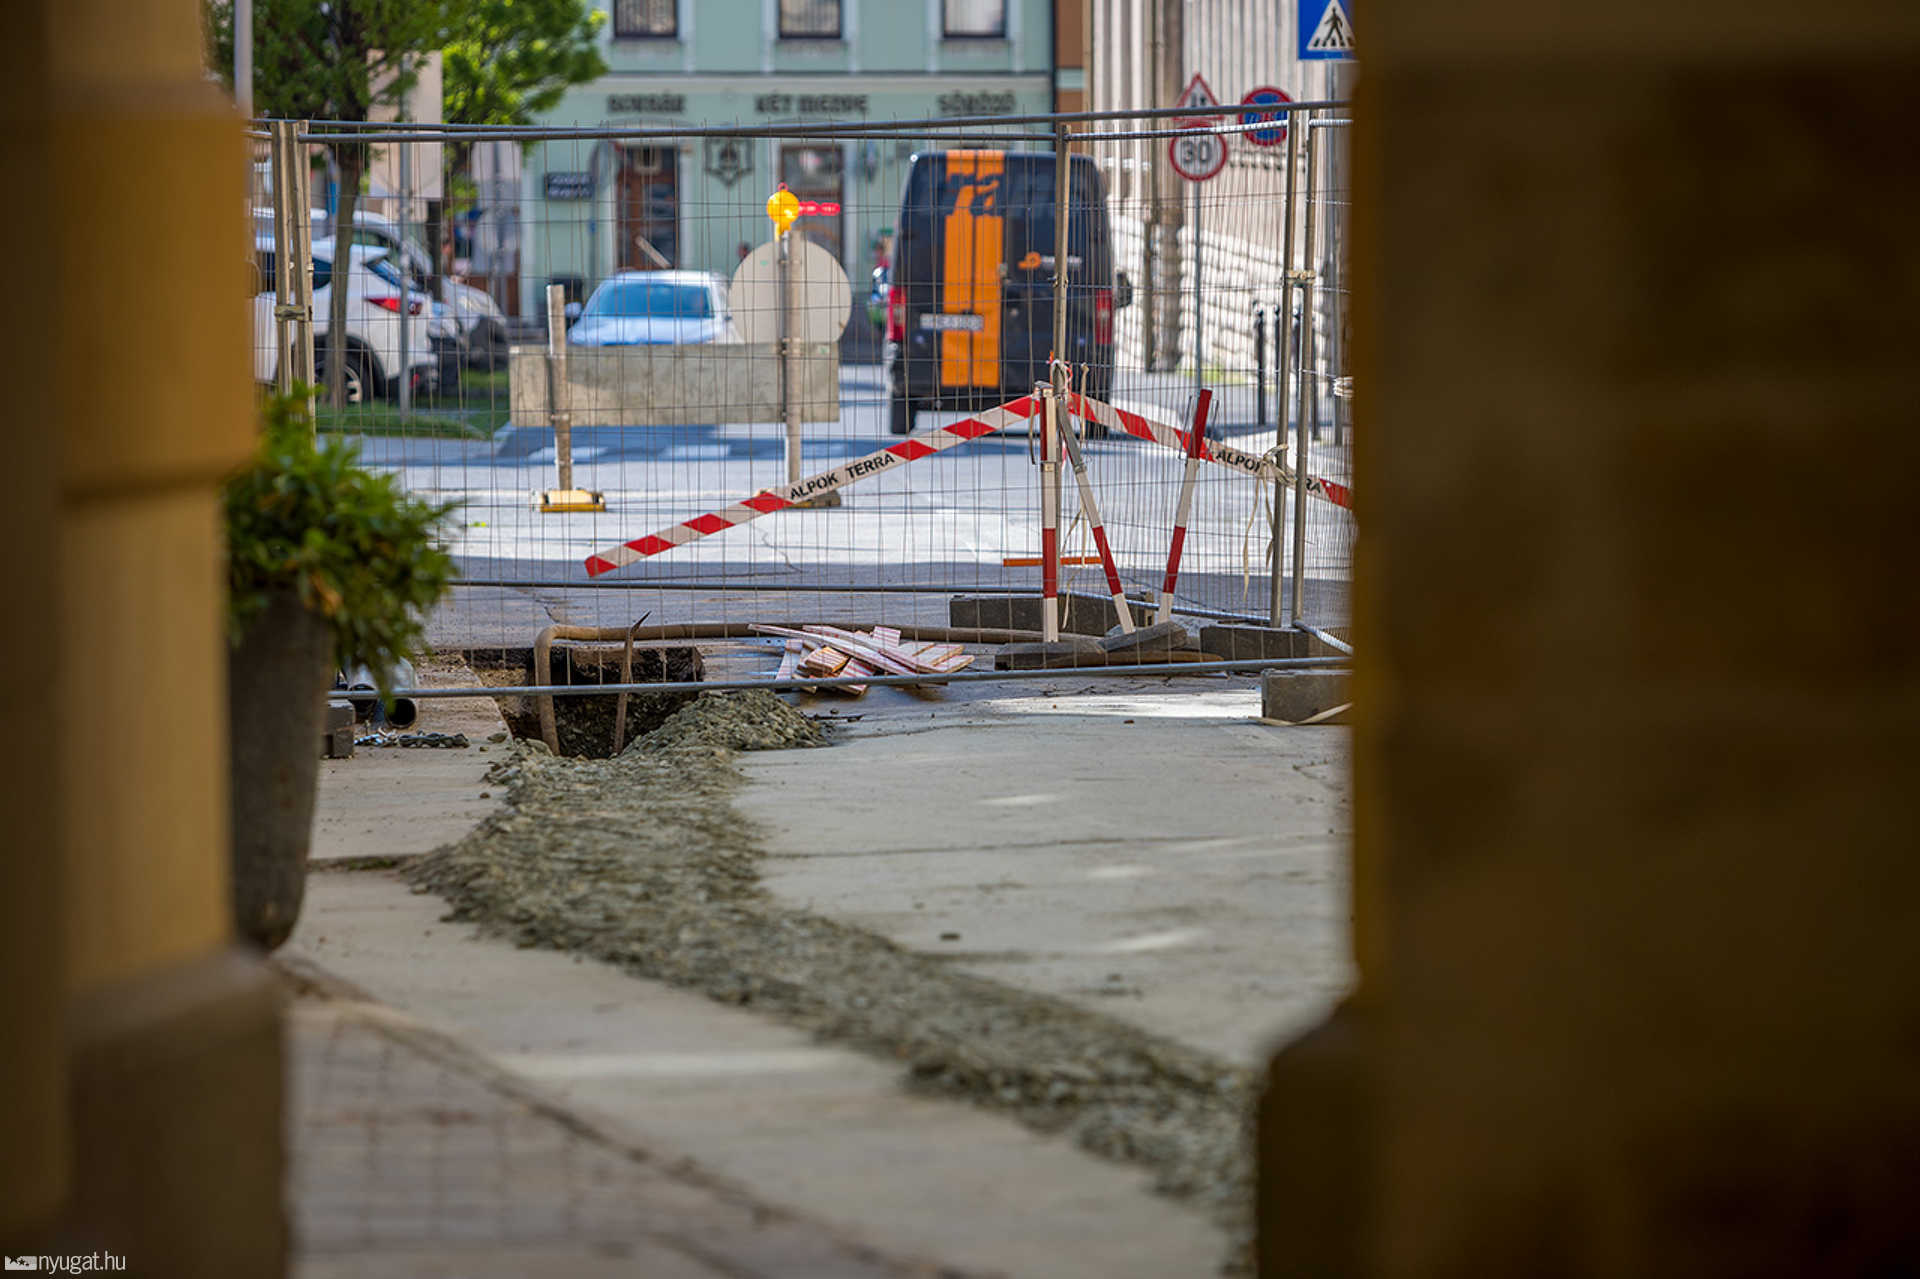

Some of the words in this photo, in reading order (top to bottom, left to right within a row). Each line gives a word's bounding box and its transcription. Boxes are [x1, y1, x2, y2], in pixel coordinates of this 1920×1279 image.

[755, 90, 792, 113] KÉT
[1181, 141, 1212, 163] 30
[790, 472, 838, 500] ALPOK
[845, 453, 896, 479] TERRA
